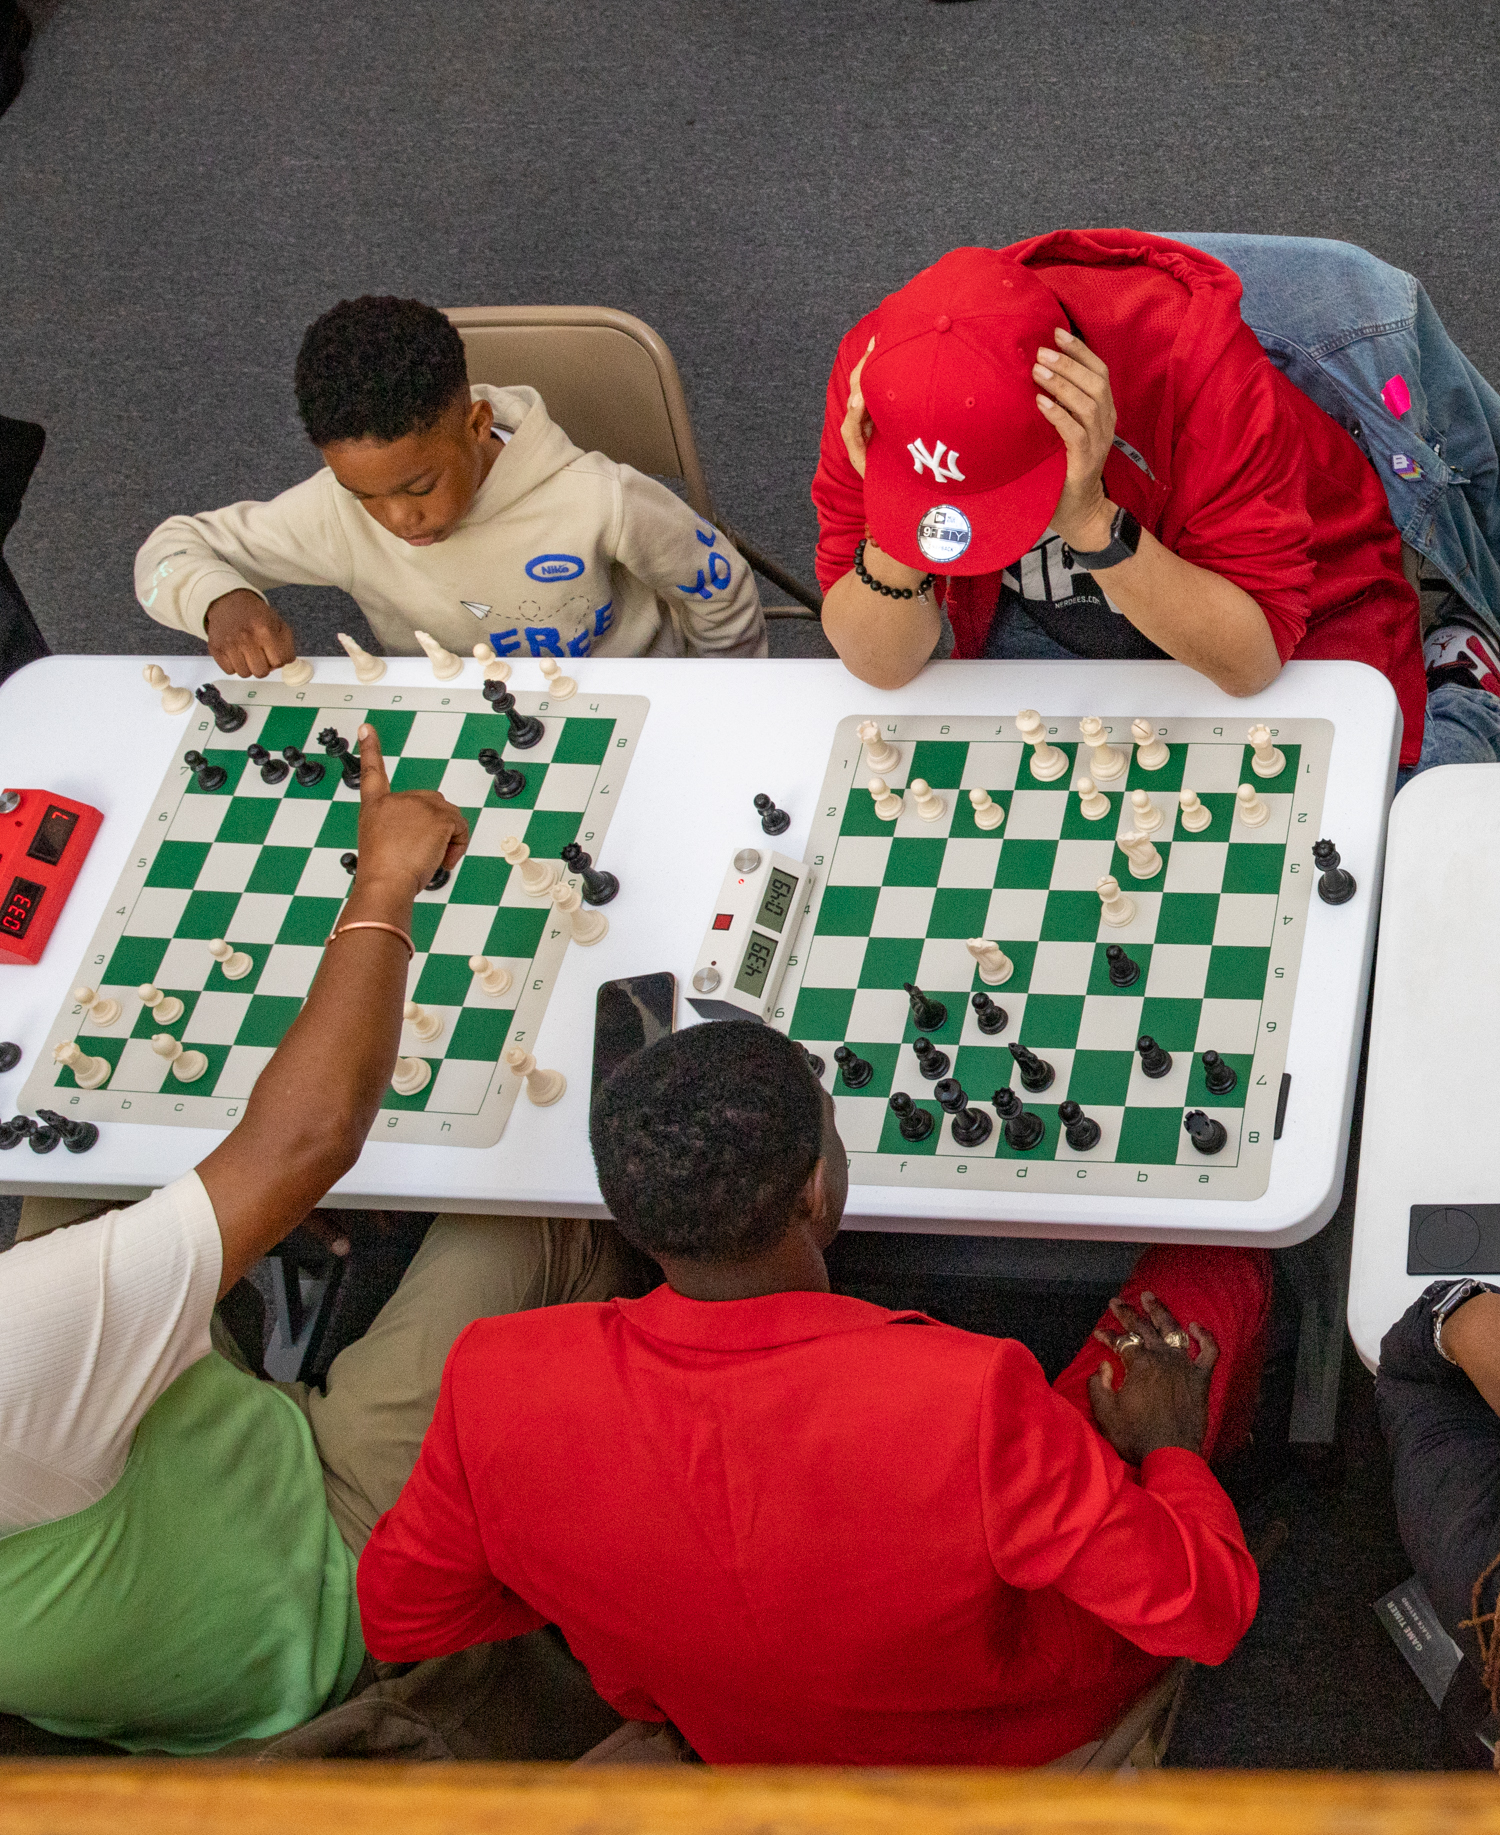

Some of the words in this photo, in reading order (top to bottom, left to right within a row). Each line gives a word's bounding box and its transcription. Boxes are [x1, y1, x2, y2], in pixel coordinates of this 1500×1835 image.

[906, 437, 966, 483] NY
[541, 564, 570, 575] Nike
[490, 600, 613, 658] FREE
[296, 692, 305, 702] b
[392, 696, 402, 704] d
[539, 702, 549, 710] g
[589, 703, 600, 713] h
[198, 722, 209, 730] 8
[887, 725, 897, 733] h
[940, 725, 950, 734] g
[995, 725, 1001, 736] f
[1158, 728, 1168, 736] c
[1213, 727, 1223, 736] b
[616, 739, 628, 747] 8
[180, 766, 188, 775] 7
[600, 785, 609, 794] 7
[158, 812, 167, 821] 6
[826, 807, 836, 816] 2
[1297, 813, 1308, 823] 2
[585, 832, 594, 841] 6
[137, 858, 146, 867] 5
[814, 855, 824, 865] 3
[1290, 863, 1300, 873] 3
[570, 880, 578, 889] 5
[765, 879, 791, 917] 0:49
[116, 907, 126, 915] 4
[803, 905, 811, 915] 4
[1282, 915, 1294, 925] 4
[551, 929, 561, 939] 4
[94, 955, 105, 965] 3
[745, 941, 770, 977] 4:39
[787, 956, 798, 967] 5
[1274, 967, 1284, 978] 5
[533, 980, 543, 990] 3
[72, 1005, 82, 1014] 2
[775, 1008, 785, 1018] 6
[1266, 1022, 1277, 1033] 6
[514, 1031, 526, 1041] 2
[1256, 1075, 1267, 1085] 7
[121, 1099, 132, 1109] b
[174, 1103, 184, 1111] c
[227, 1107, 238, 1116] d
[387, 1117, 399, 1128] g
[441, 1121, 451, 1131] h
[1248, 1131, 1260, 1143] 8
[900, 1161, 907, 1172] f
[957, 1165, 967, 1173] e
[1016, 1167, 1028, 1178] d
[1076, 1170, 1087, 1179] c
[1137, 1171, 1148, 1182] b
[1198, 1175, 1209, 1183] a
[1387, 1601, 1407, 1628] TIMER
[1403, 1626, 1423, 1651] GAME
